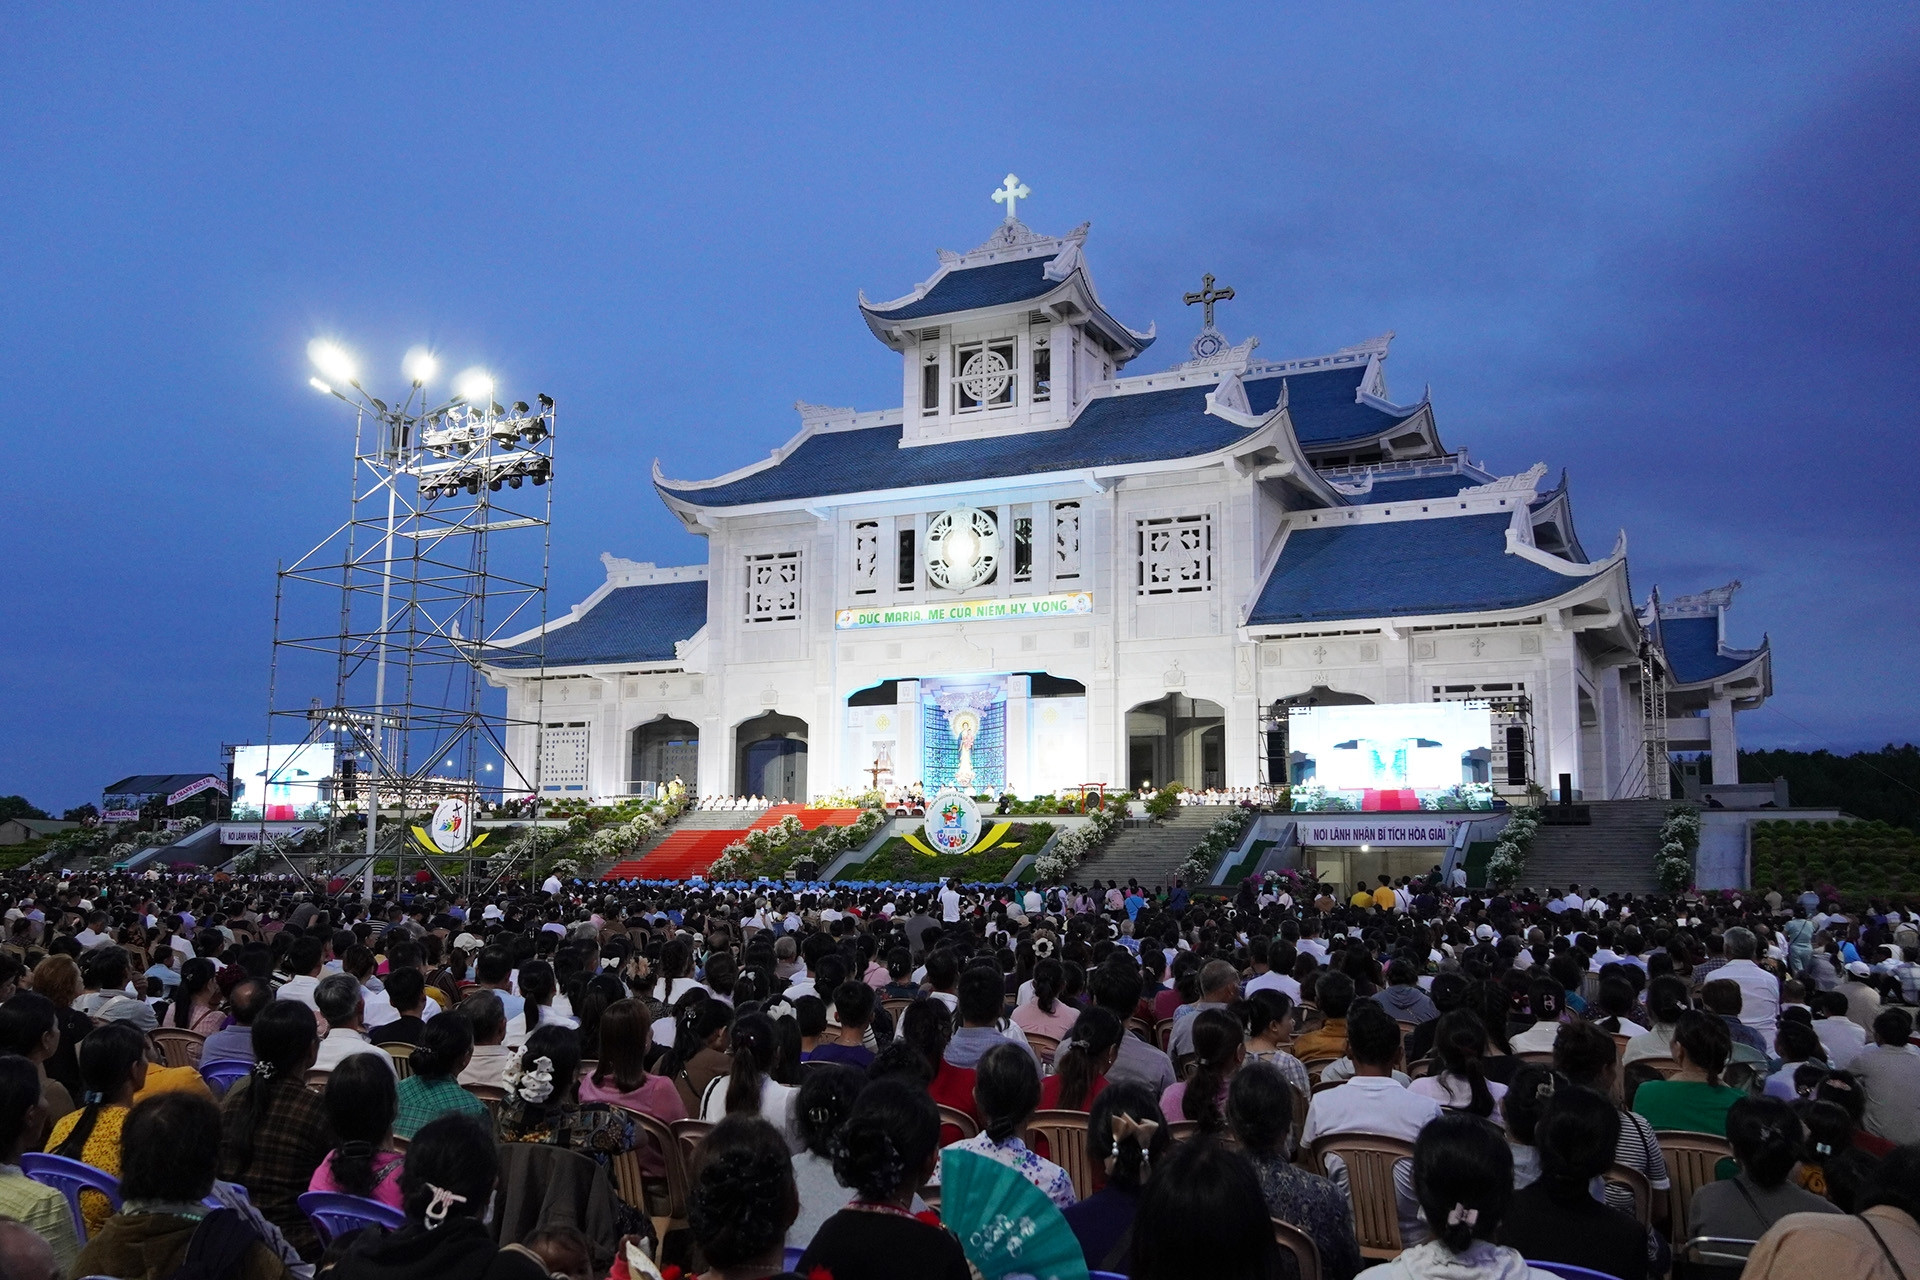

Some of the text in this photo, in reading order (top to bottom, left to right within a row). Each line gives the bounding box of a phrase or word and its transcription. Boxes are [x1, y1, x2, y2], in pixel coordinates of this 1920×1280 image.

[859, 611, 880, 625] ĐỨC
[884, 611, 923, 623] MARIA,
[928, 608, 945, 622] MẸ
[949, 604, 972, 619] CỦA
[1010, 603, 1027, 615] HY
[1032, 600, 1068, 616] VỌNG
[1352, 825, 1376, 843] NHẬN
[1377, 826, 1386, 841] BÍ
[1388, 826, 1406, 841] TÍCH
[1408, 825, 1427, 841] HÒA
[1428, 825, 1446, 841] GIẢI
